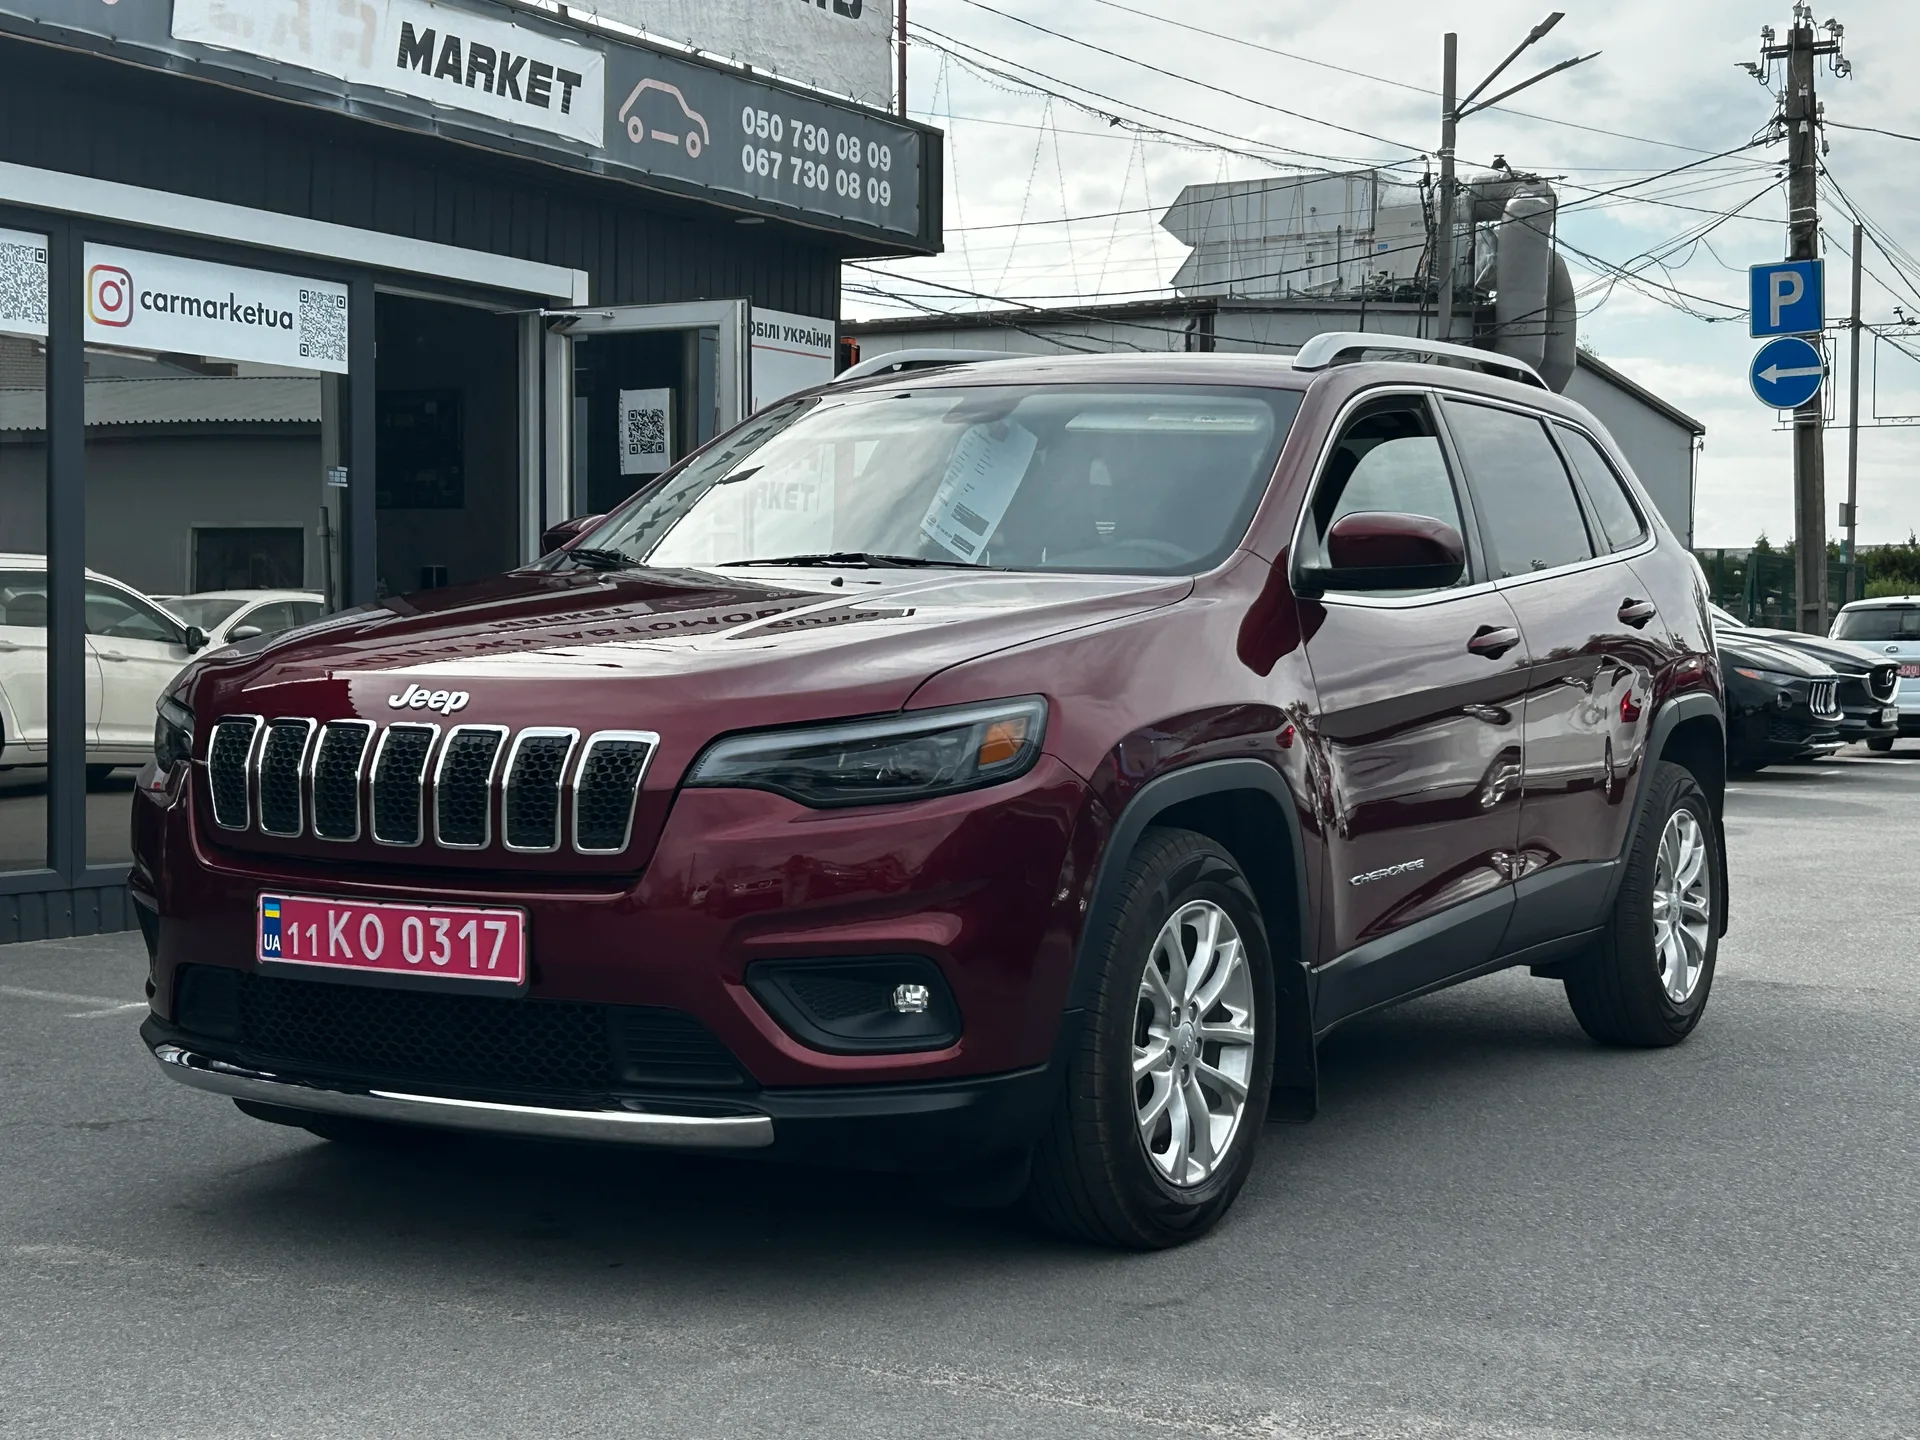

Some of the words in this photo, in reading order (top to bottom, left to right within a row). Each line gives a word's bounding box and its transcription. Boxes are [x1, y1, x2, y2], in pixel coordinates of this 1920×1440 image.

[397, 21, 582, 115] MARKET
[742, 106, 783, 142] 050
[790, 119, 830, 155] 730
[836, 133, 861, 164] 08
[867, 141, 892, 172] 09
[742, 144, 783, 180] 067
[790, 156, 830, 192] 730
[836, 169, 861, 199] 08
[867, 177, 892, 207] 09
[140, 290, 293, 330] carmarketua
[1769, 271, 1804, 327] P
[783, 326, 832, 349] УКРАЇНИ
[388, 683, 470, 716] Jeep
[264, 933, 281, 951] UA
[401, 915, 508, 970] 0317
